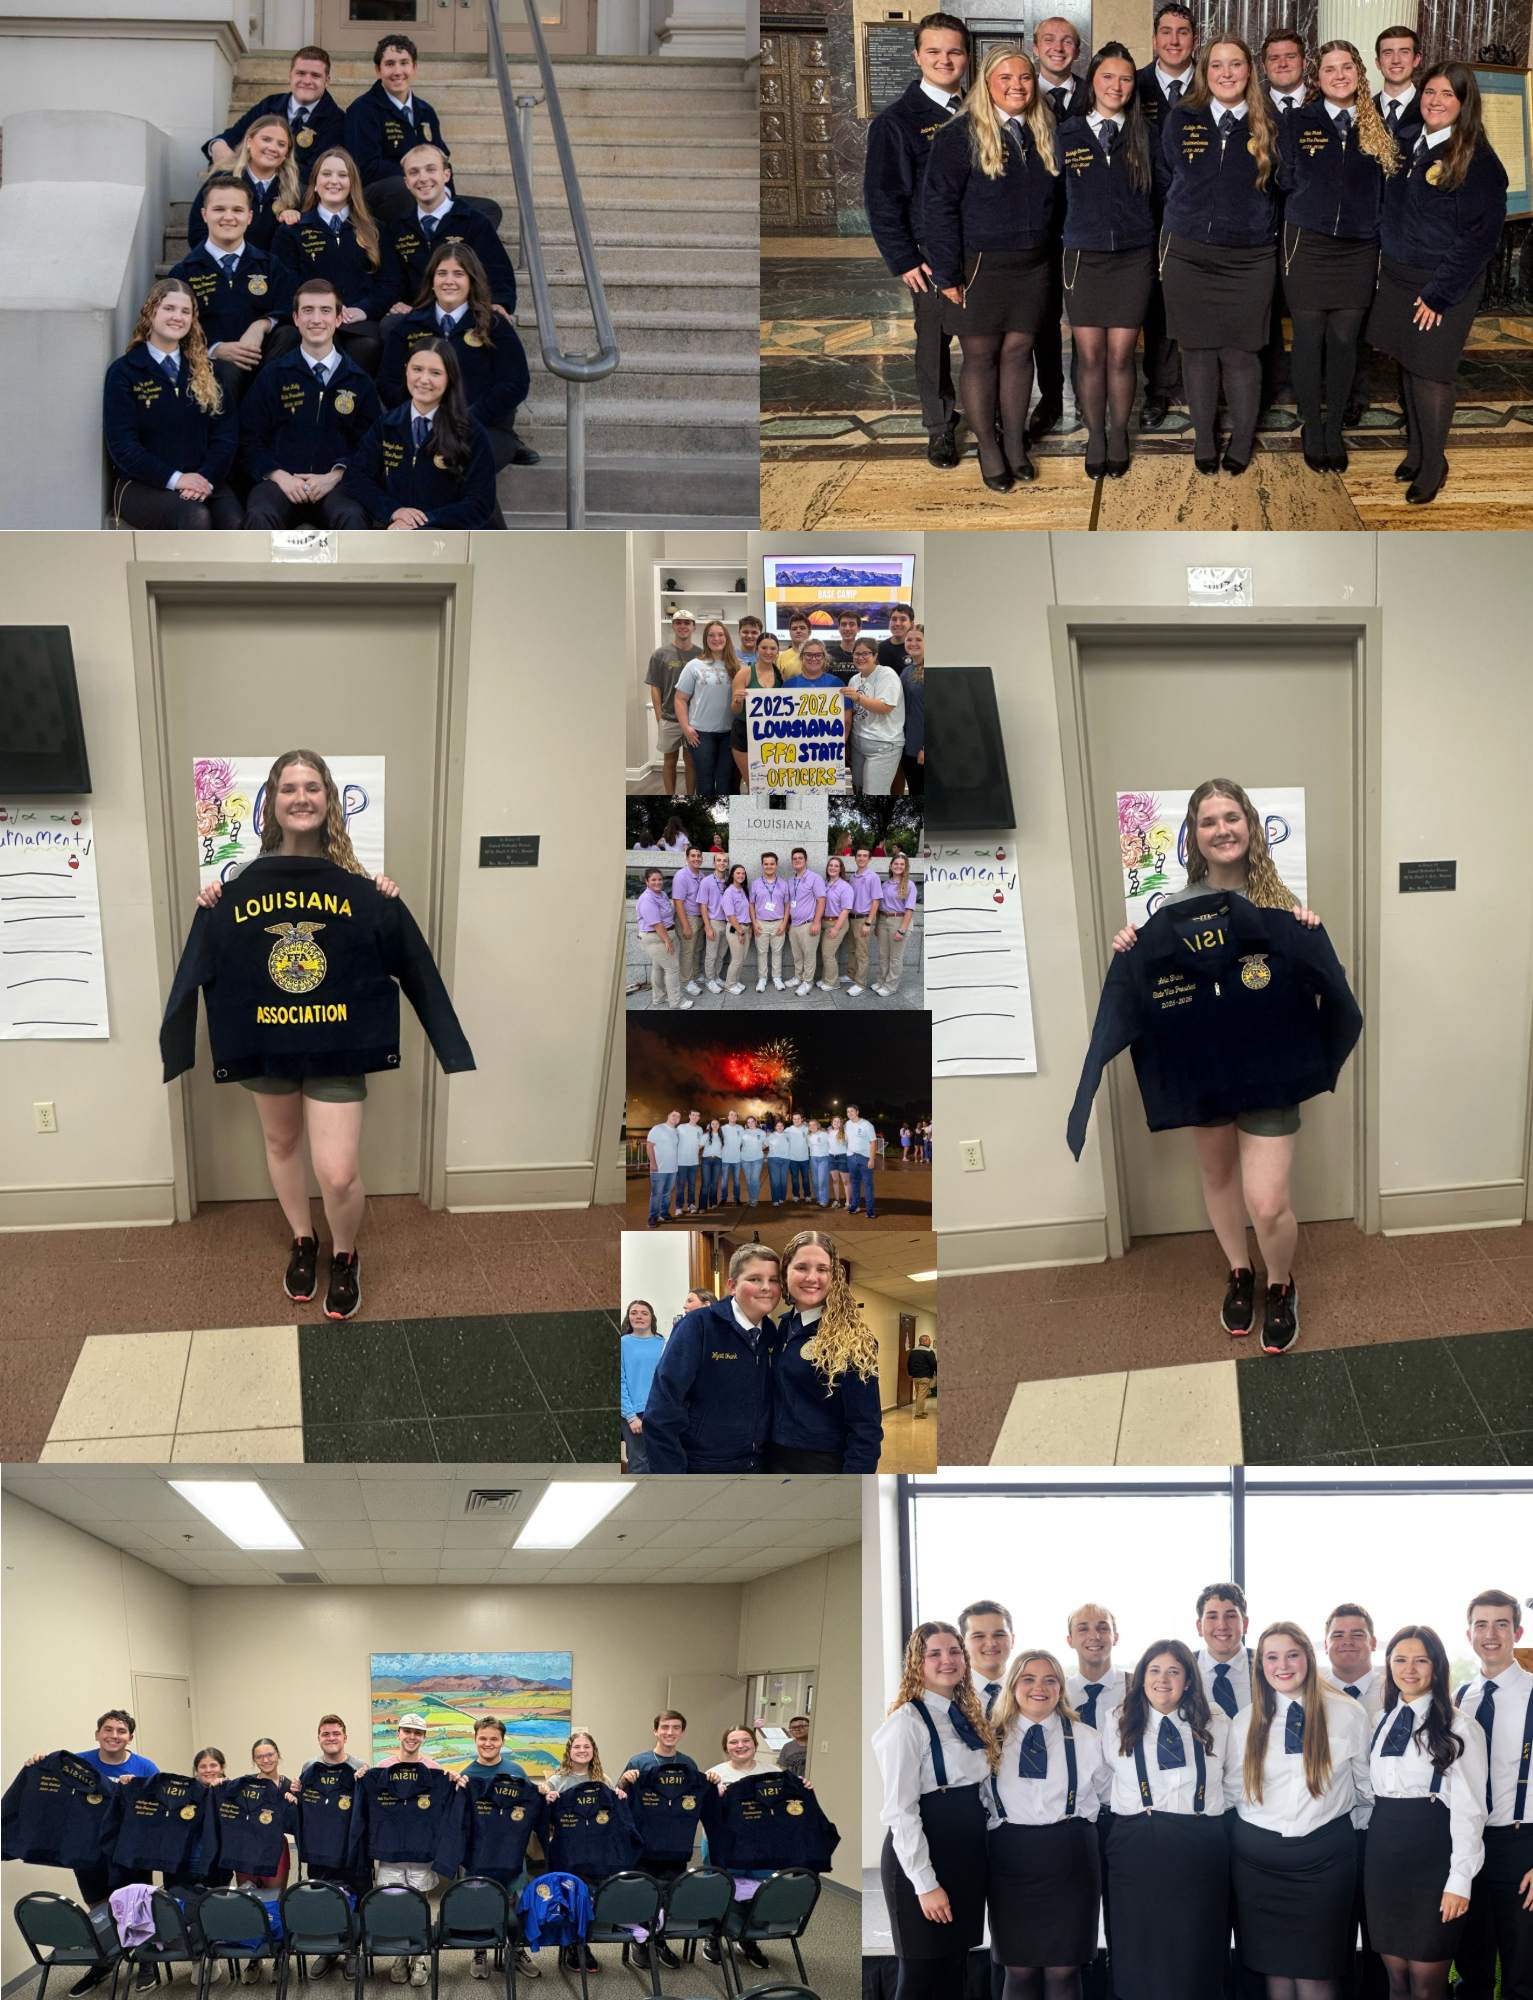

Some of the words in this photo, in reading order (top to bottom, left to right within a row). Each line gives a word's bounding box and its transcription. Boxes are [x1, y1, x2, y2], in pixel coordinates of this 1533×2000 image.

[817, 589, 835, 599] BASE
[836, 589, 857, 599] CAMP
[749, 694, 841, 717] 2025-2026
[753, 719, 844, 741] LOUISIANA
[761, 742, 796, 764] FFA
[798, 742, 845, 762] STATE
[767, 767, 836, 787] OFFICERS
[747, 818, 811, 830] LOUISIANA
[235, 891, 352, 923] LOUISIANA
[287, 953, 308, 961] FFA
[1153, 990, 1165, 999] State
[1164, 987, 1174, 996] Vice
[1174, 983, 1196, 994] President
[1161, 996, 1193, 1009] 2025-2026
[257, 1003, 347, 1024] ASSOCIATION
[1141, 1781, 1149, 1797] FFA
